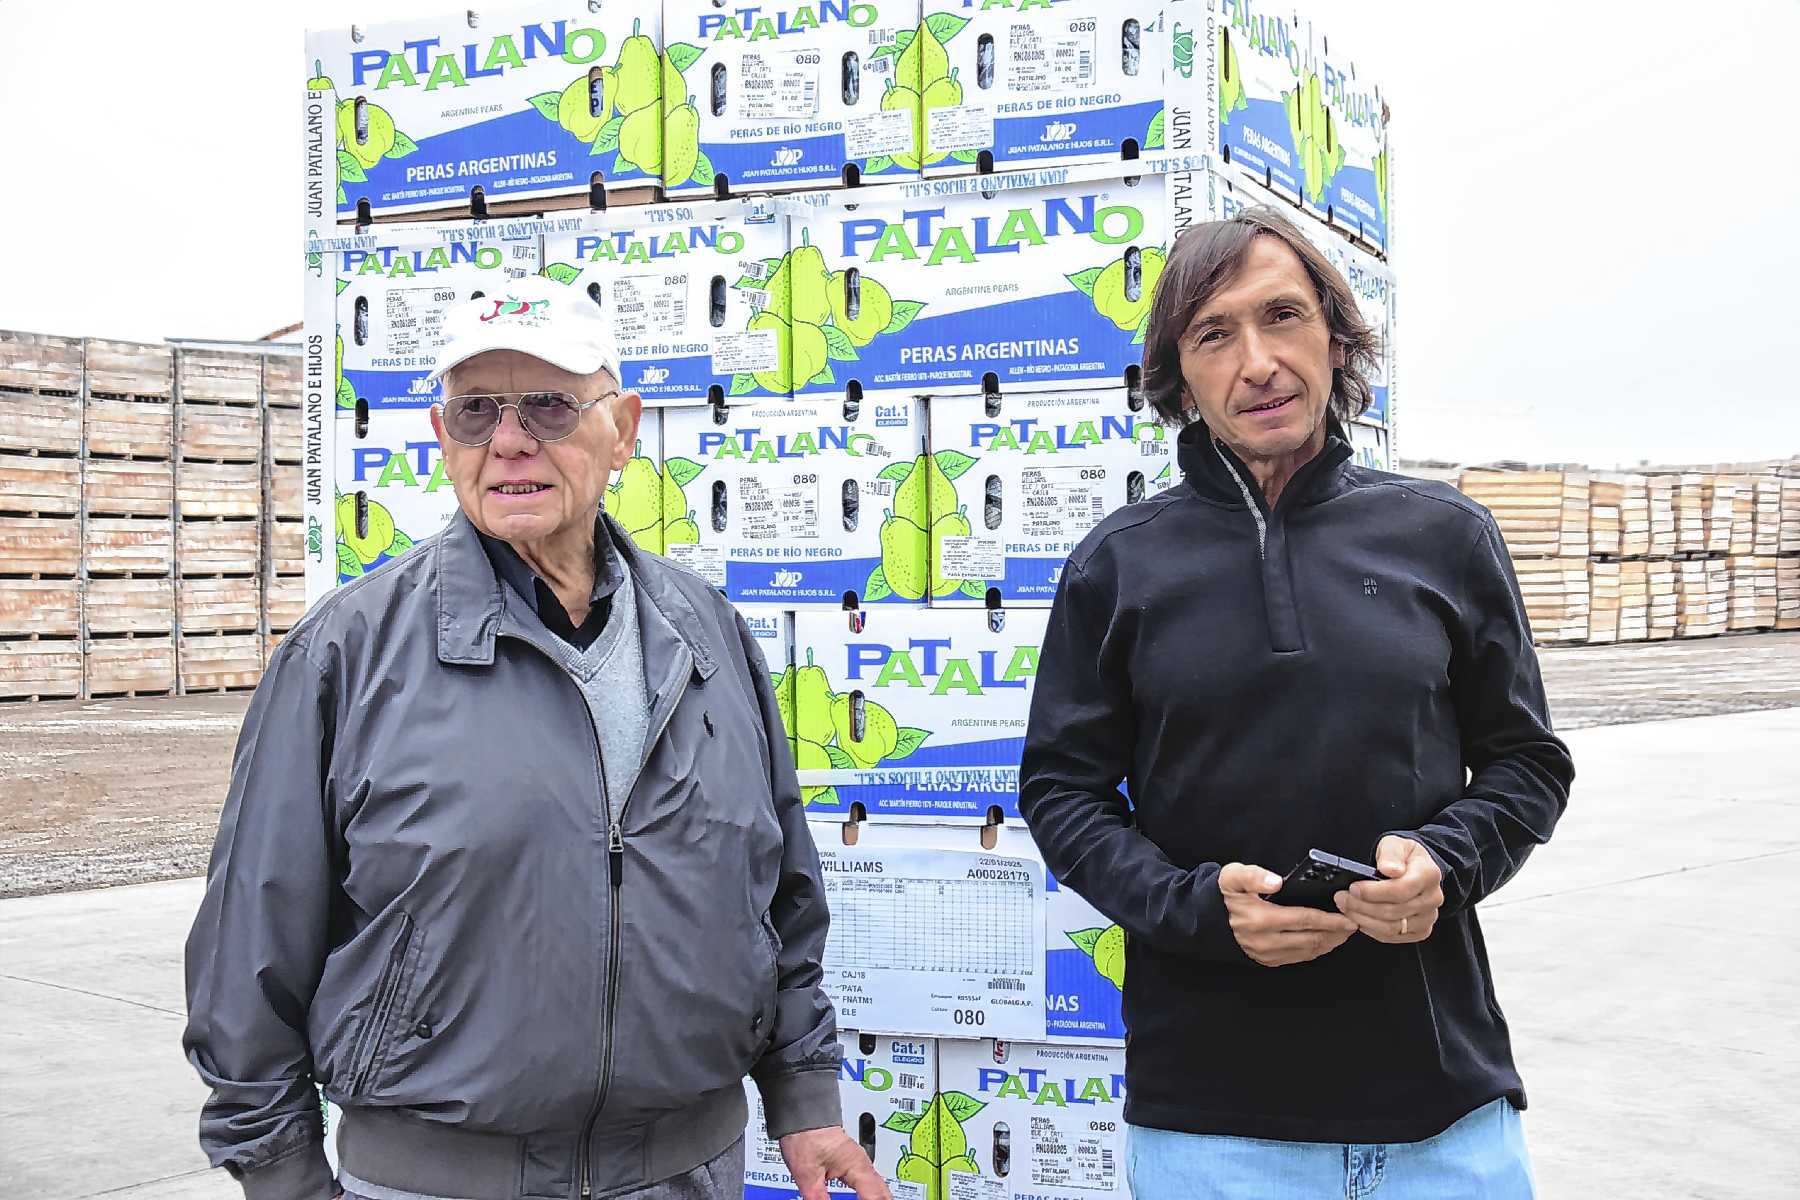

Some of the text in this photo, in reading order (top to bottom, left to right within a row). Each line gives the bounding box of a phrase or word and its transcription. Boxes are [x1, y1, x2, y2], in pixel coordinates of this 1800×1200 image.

[698, 0, 879, 42] PATALANO
[1069, 22, 1096, 32] 080
[350, 20, 607, 91] PATALANO
[796, 54, 820, 64] 080
[1207, 16, 1215, 105] PATALANO
[997, 93, 1121, 113] PERAS DE RÍO NEGRO
[730, 122, 842, 139] PERAS DE RÍO NEGRO
[1173, 107, 1191, 150] JUAN
[1008, 145, 1027, 154] JUAN
[1028, 142, 1064, 152] PATALANO
[1071, 140, 1093, 149] HIJOS
[308, 91, 323, 218] JUAN PATALANO E
[406, 150, 557, 183] PERAS ARGENTINAS
[742, 169, 759, 178] JUAN
[760, 167, 793, 177] PATALANO
[799, 165, 818, 173] HIJOS
[981, 172, 1036, 191] PATALANO
[1040, 169, 1068, 184] JUAN
[934, 180, 967, 195] HIJOS
[507, 220, 555, 236] PATALANO
[558, 218, 583, 232] JUAN
[839, 194, 1144, 267] PATALANO
[467, 225, 495, 240] HIJOS
[354, 236, 378, 249] JUAN
[575, 224, 745, 265] PATALANO
[342, 240, 503, 278] PATALANO
[664, 275, 687, 285] 080
[434, 291, 455, 301] 080
[945, 283, 1019, 296] ARGENTINE PEARS
[635, 347, 649, 355] DE
[651, 344, 669, 355] RÍO
[672, 343, 709, 354] NEGRO
[900, 337, 1080, 364] PERAS ARGENTINAS
[371, 354, 436, 367] PERAS DE RÍO
[307, 334, 322, 505] JUAN PATALANO E HIJOS
[351, 440, 455, 493] PATA
[793, 474, 817, 484] 080
[1080, 469, 1106, 480] 080
[730, 546, 842, 557] PERAS DE RÍO NEGRO
[1005, 543, 1060, 553] PERAS DE
[740, 589, 758, 597] JUAN
[759, 589, 791, 597] PATALANO
[797, 589, 817, 597] HIJOS
[843, 637, 1040, 696] PATALA
[951, 718, 1026, 728] ARGENTINE PEARS
[889, 771, 920, 785] HIJOS
[936, 770, 993, 784] PATALANO
[994, 769, 1018, 783] UAN
[820, 860, 883, 873] WILLIAMS
[966, 868, 1030, 881] A00028179
[841, 984, 863, 993] PATA
[841, 1008, 857, 1016] ELE
[953, 1009, 985, 1026] 080
[1036, 1050, 1109, 1062] PRODUCCIÓN ARGENTINA
[1089, 1121, 1116, 1132] 080
[745, 1171, 779, 1182] PERAS
